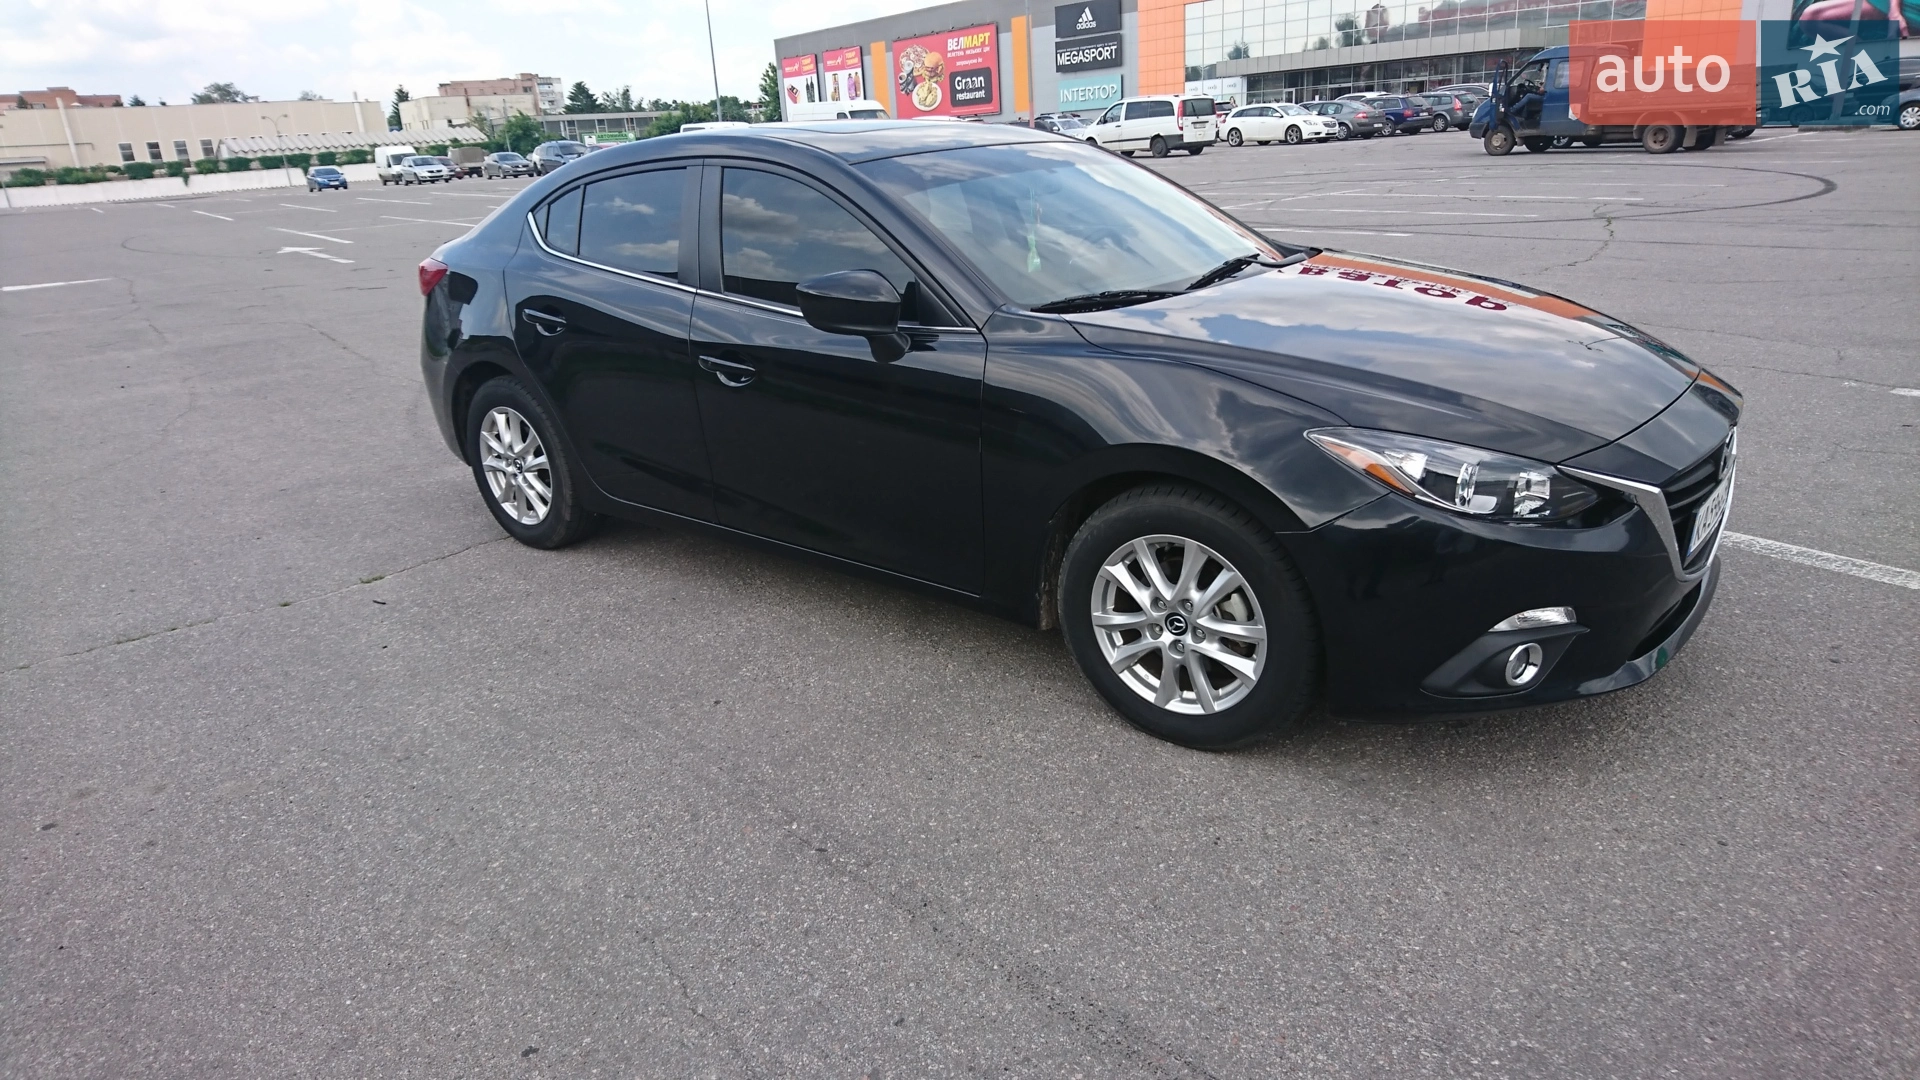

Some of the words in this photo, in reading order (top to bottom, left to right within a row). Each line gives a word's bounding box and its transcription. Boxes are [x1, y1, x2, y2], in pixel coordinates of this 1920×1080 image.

[1076, 20, 1097, 30] adidas
[947, 32, 990, 52] ВЕЛМАРТ
[1057, 45, 1117, 66] MEGASPORT
[955, 75, 985, 90] Graan
[956, 89, 985, 101] restaurant
[1060, 84, 1117, 103] INTERTOP
